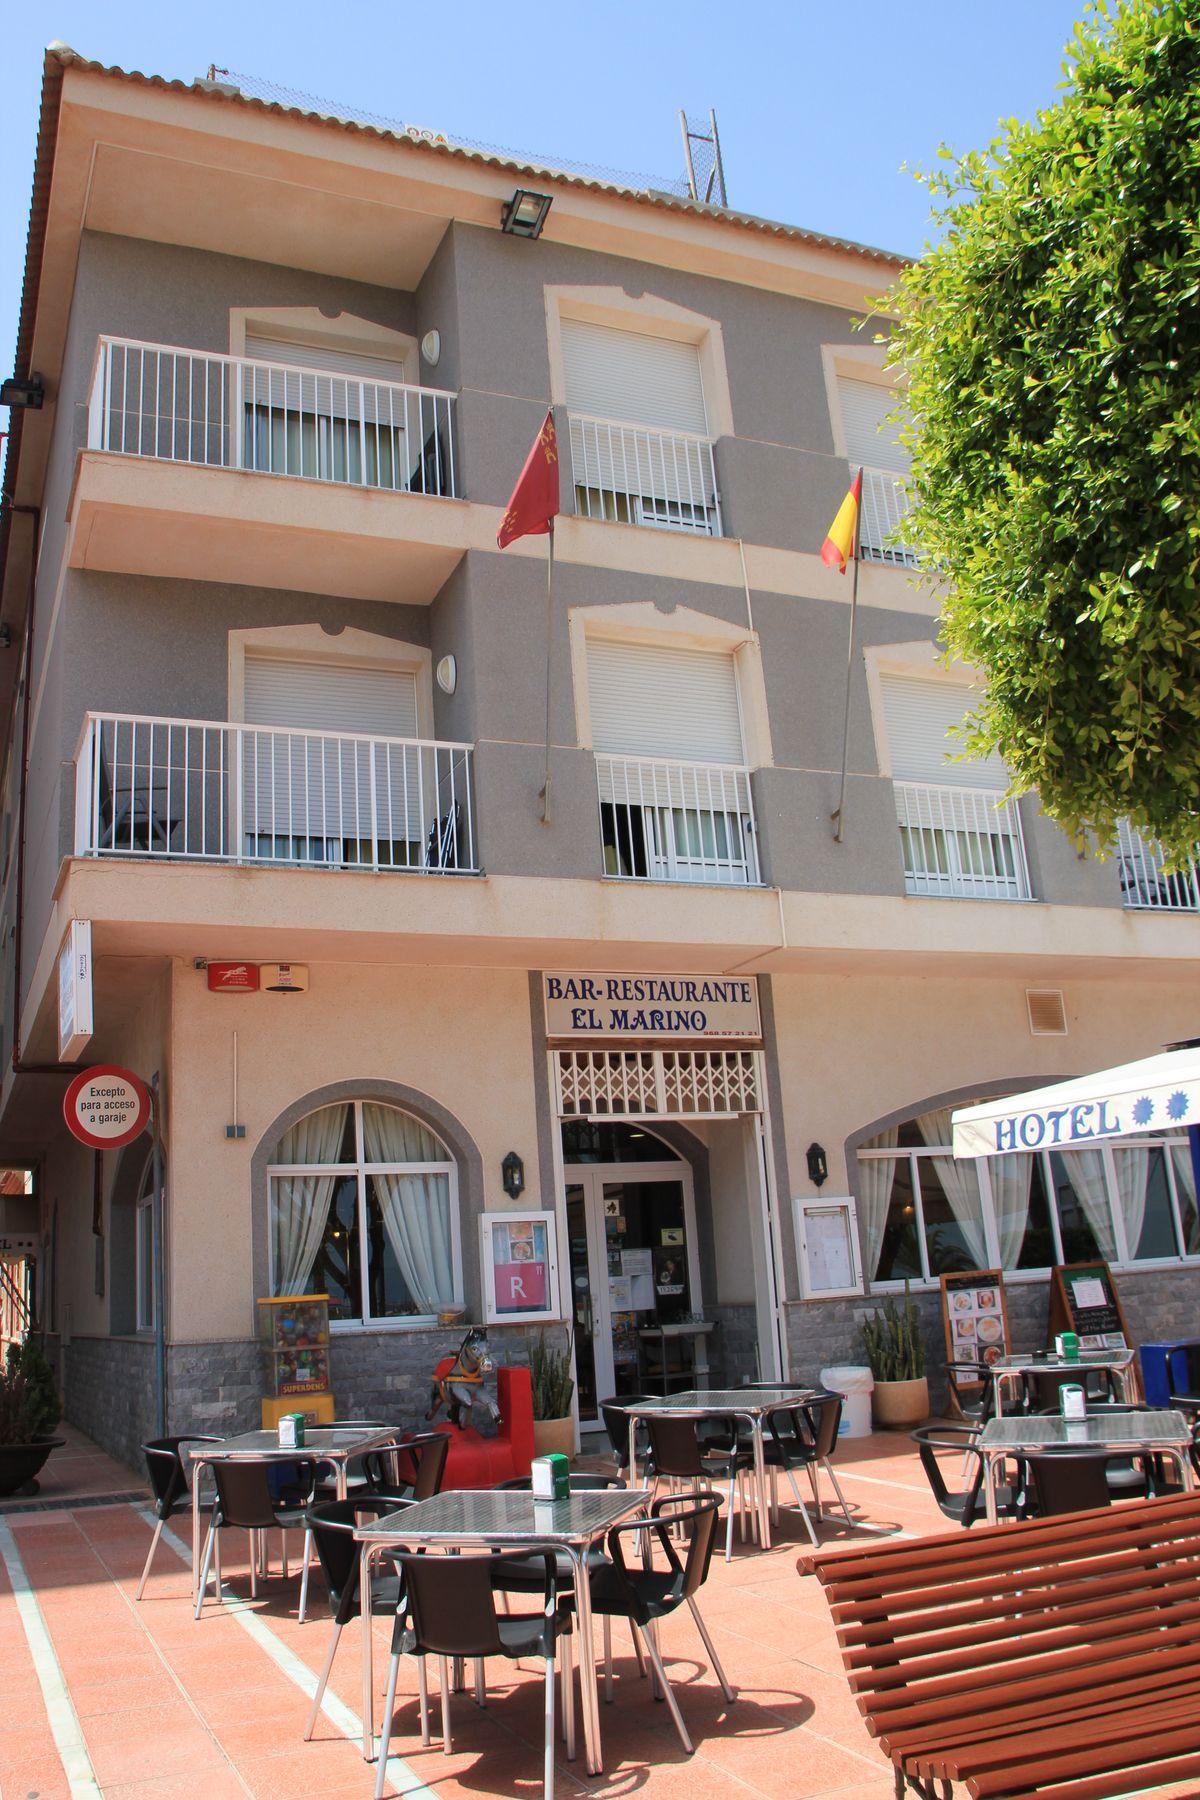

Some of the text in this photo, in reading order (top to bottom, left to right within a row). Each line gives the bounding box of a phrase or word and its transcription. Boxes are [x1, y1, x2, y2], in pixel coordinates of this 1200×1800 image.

[571, 1007, 708, 1032] EL MARINO
[90, 1087, 126, 1098] Excepto
[80, 1100, 136, 1112] para acceso
[90, 1112, 127, 1125] a garaje
[993, 1099, 1122, 1152] HOTEL
[510, 1275, 528, 1299] R
